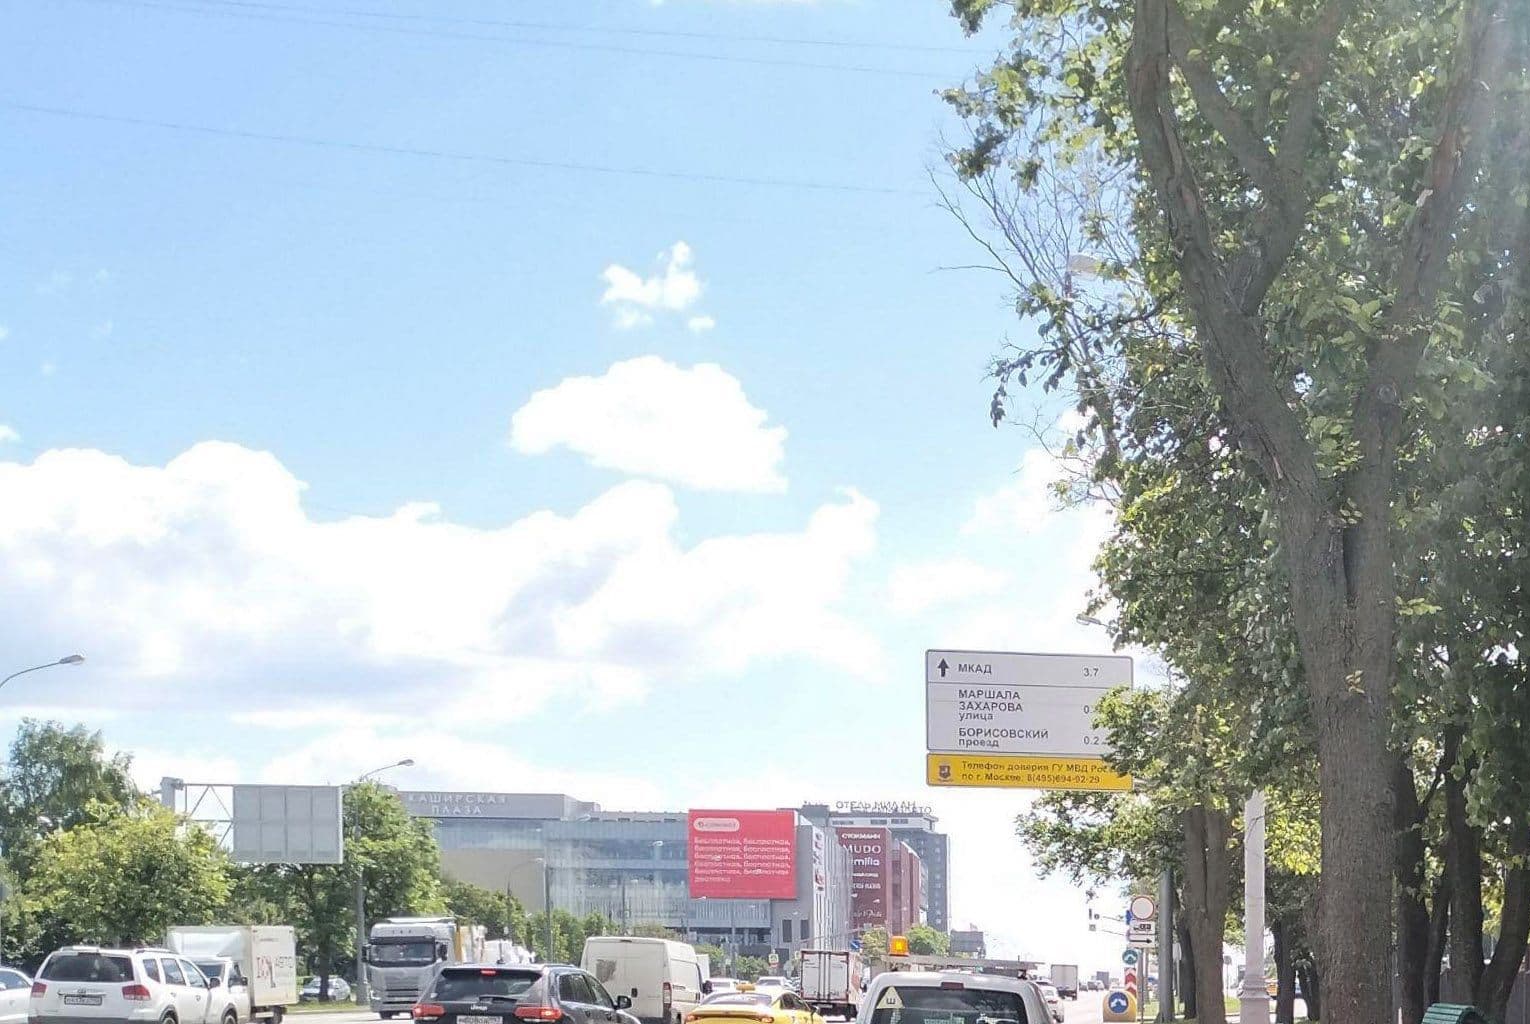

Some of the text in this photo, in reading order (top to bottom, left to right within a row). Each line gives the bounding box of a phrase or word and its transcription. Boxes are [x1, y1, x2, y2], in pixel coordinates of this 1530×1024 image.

[958, 663, 992, 675] МКАД
[1083, 667, 1099, 678] 3.7
[958, 690, 1021, 700] МАРШАЛА
[958, 701, 1023, 713] ЗАХАРОВА
[958, 712, 994, 722] улица
[958, 728, 1049, 739] БОРИСОВСКИЙ
[958, 738, 999, 748] проезд
[962, 761, 1005, 772] Телефон
[1051, 764, 1063, 772] ГУ
[1066, 765, 1088, 773] МВД
[836, 800, 871, 809] ОТЕЛЬ
[431, 805, 482, 815] ПЛАЗА
